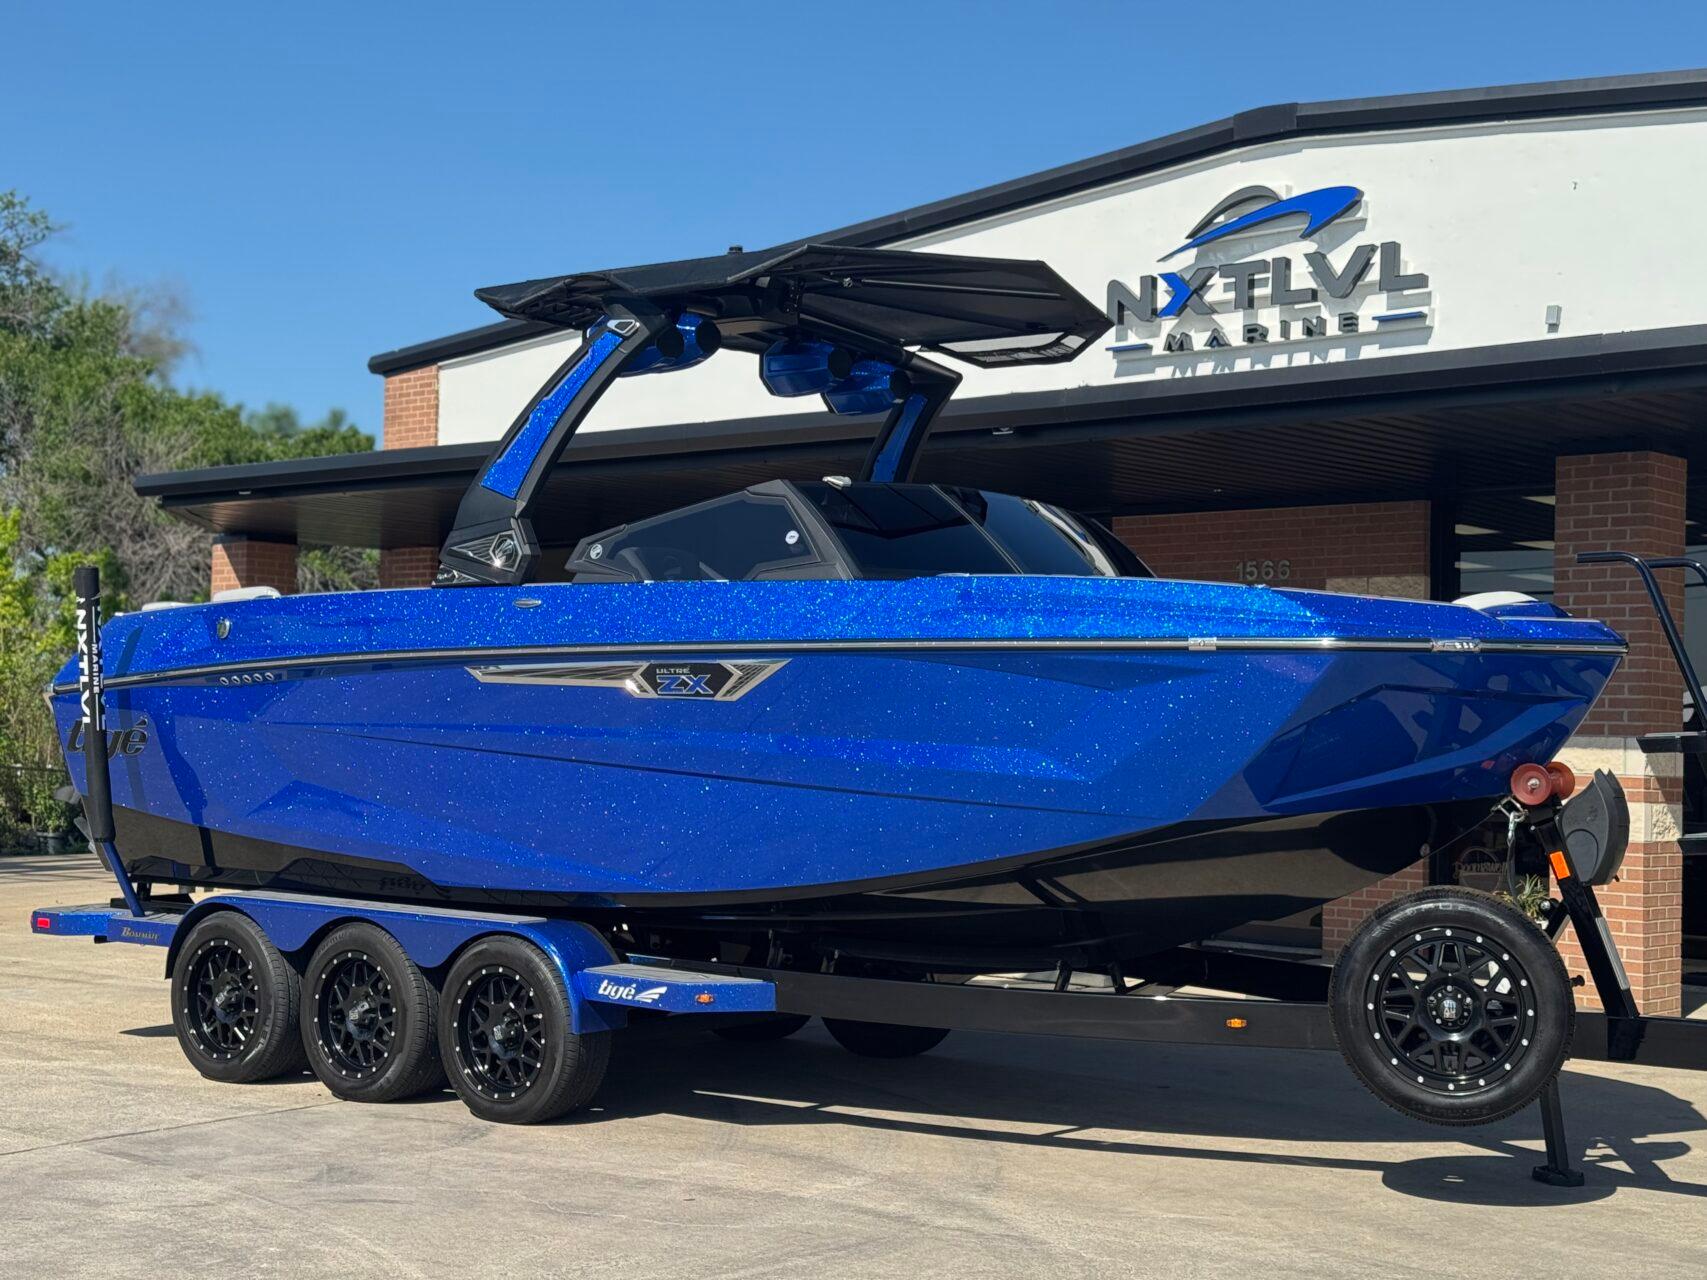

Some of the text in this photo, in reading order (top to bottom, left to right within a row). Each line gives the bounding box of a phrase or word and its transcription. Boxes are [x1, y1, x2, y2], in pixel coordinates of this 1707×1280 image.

[1107, 241, 1429, 326] NXTLVL
[1163, 311, 1359, 351] MARINE
[1236, 560, 1291, 581] 1566
[91, 643, 101, 694] MARINE
[656, 674, 714, 694] ZX
[598, 979, 637, 1000] tigé
